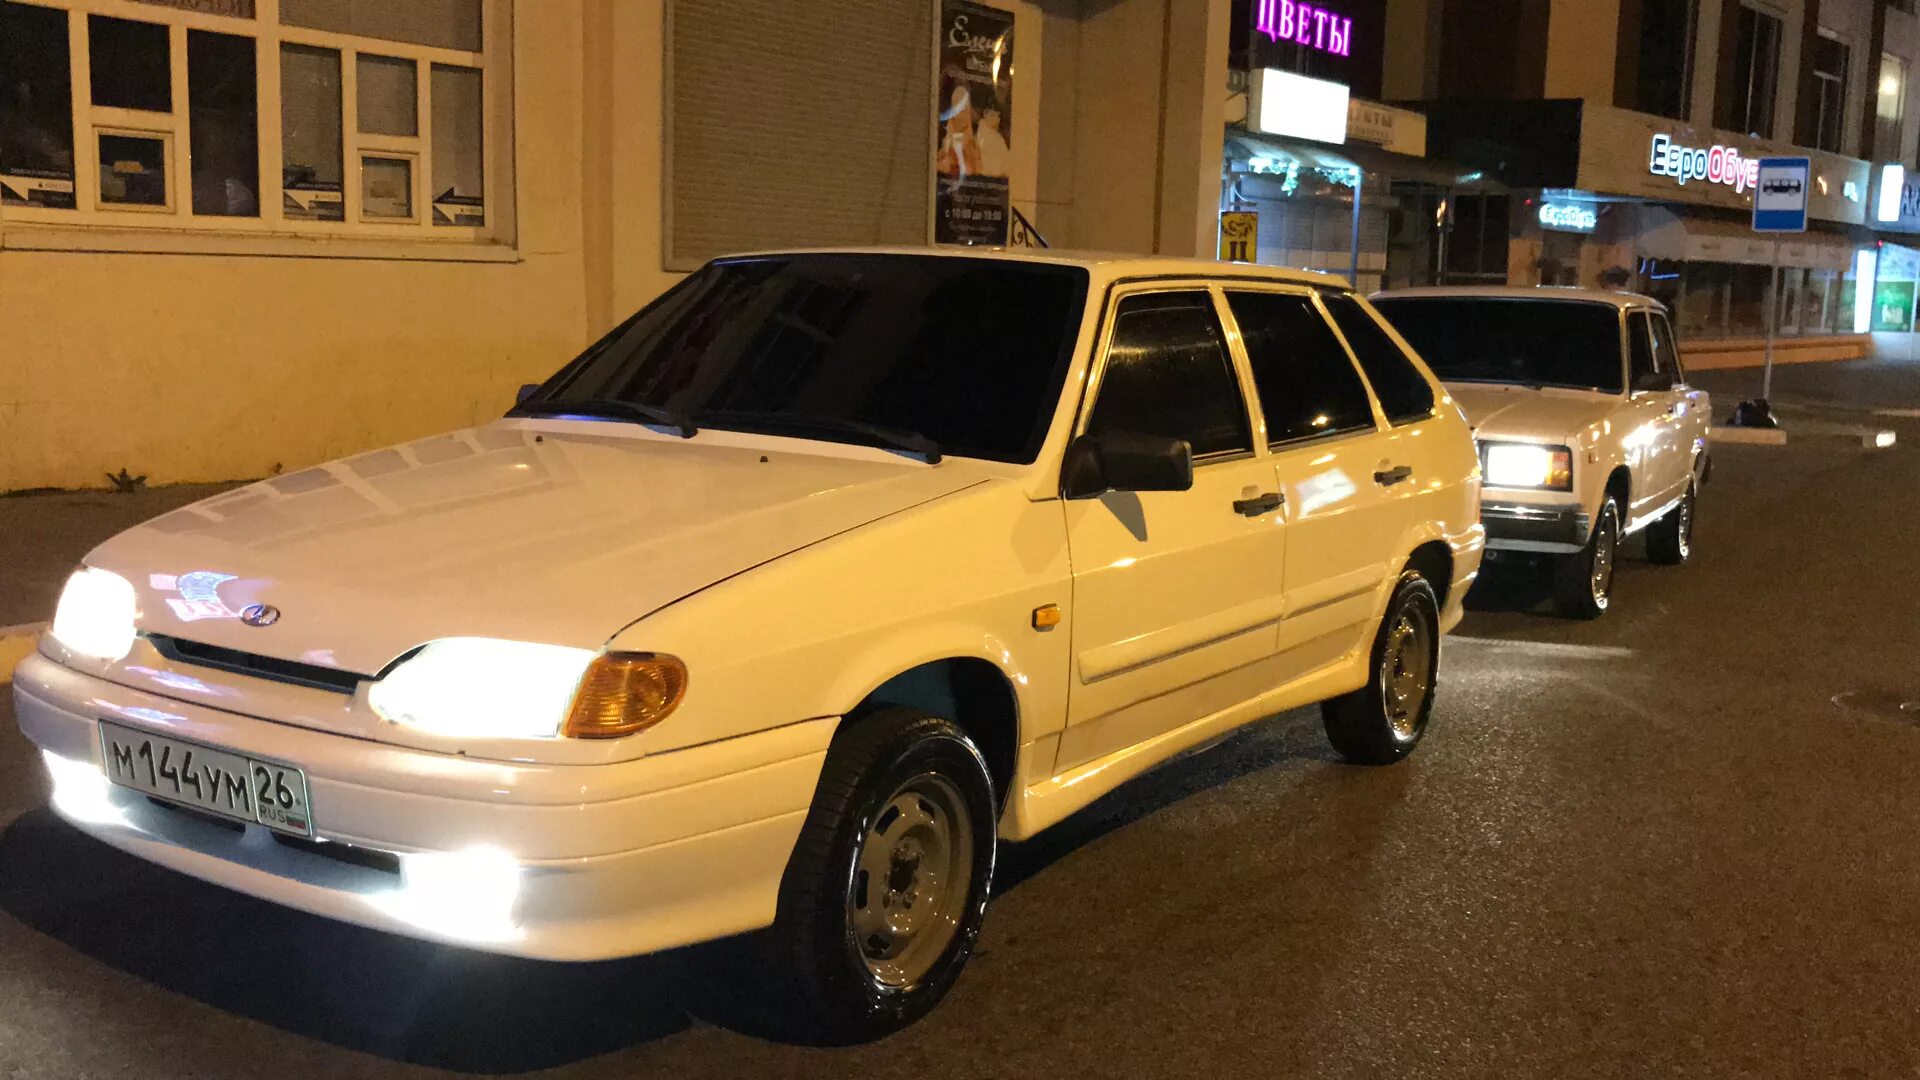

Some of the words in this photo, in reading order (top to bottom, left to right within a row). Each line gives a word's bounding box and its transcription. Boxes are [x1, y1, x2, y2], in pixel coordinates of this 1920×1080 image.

[1256, 0, 1352, 57] ЦВЕТЫ
[1650, 133, 1760, 194] ЕвроОбув
[113, 740, 251, 813] М144УМ
[255, 766, 295, 810] 26
[259, 803, 287, 823] RUS
